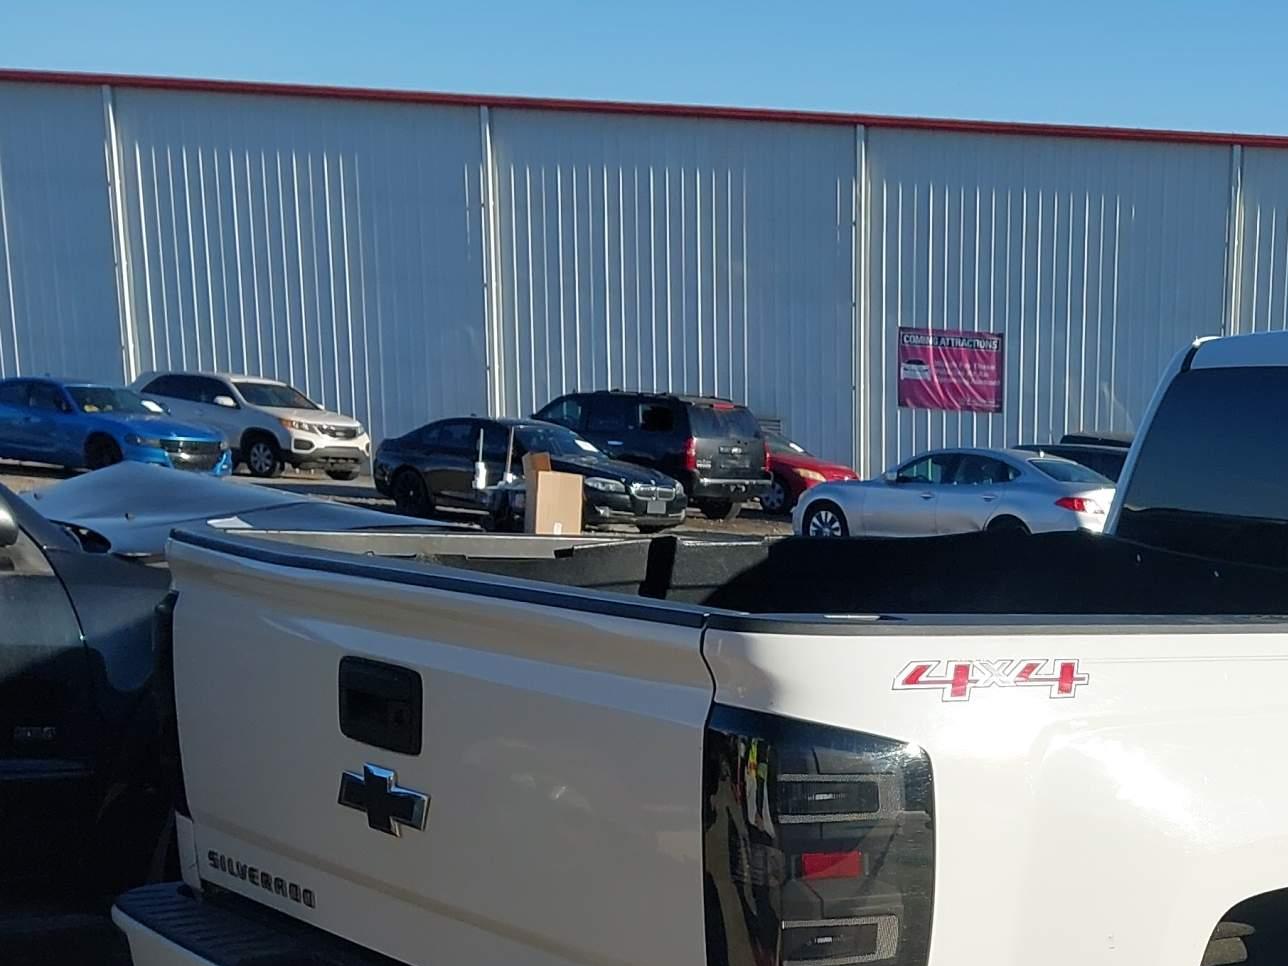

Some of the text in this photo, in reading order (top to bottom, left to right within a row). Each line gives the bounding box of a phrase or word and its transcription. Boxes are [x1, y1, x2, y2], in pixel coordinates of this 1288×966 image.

[903, 334, 998, 350] COMING ATTRACTIONS
[207, 849, 316, 909] SILVERADO
